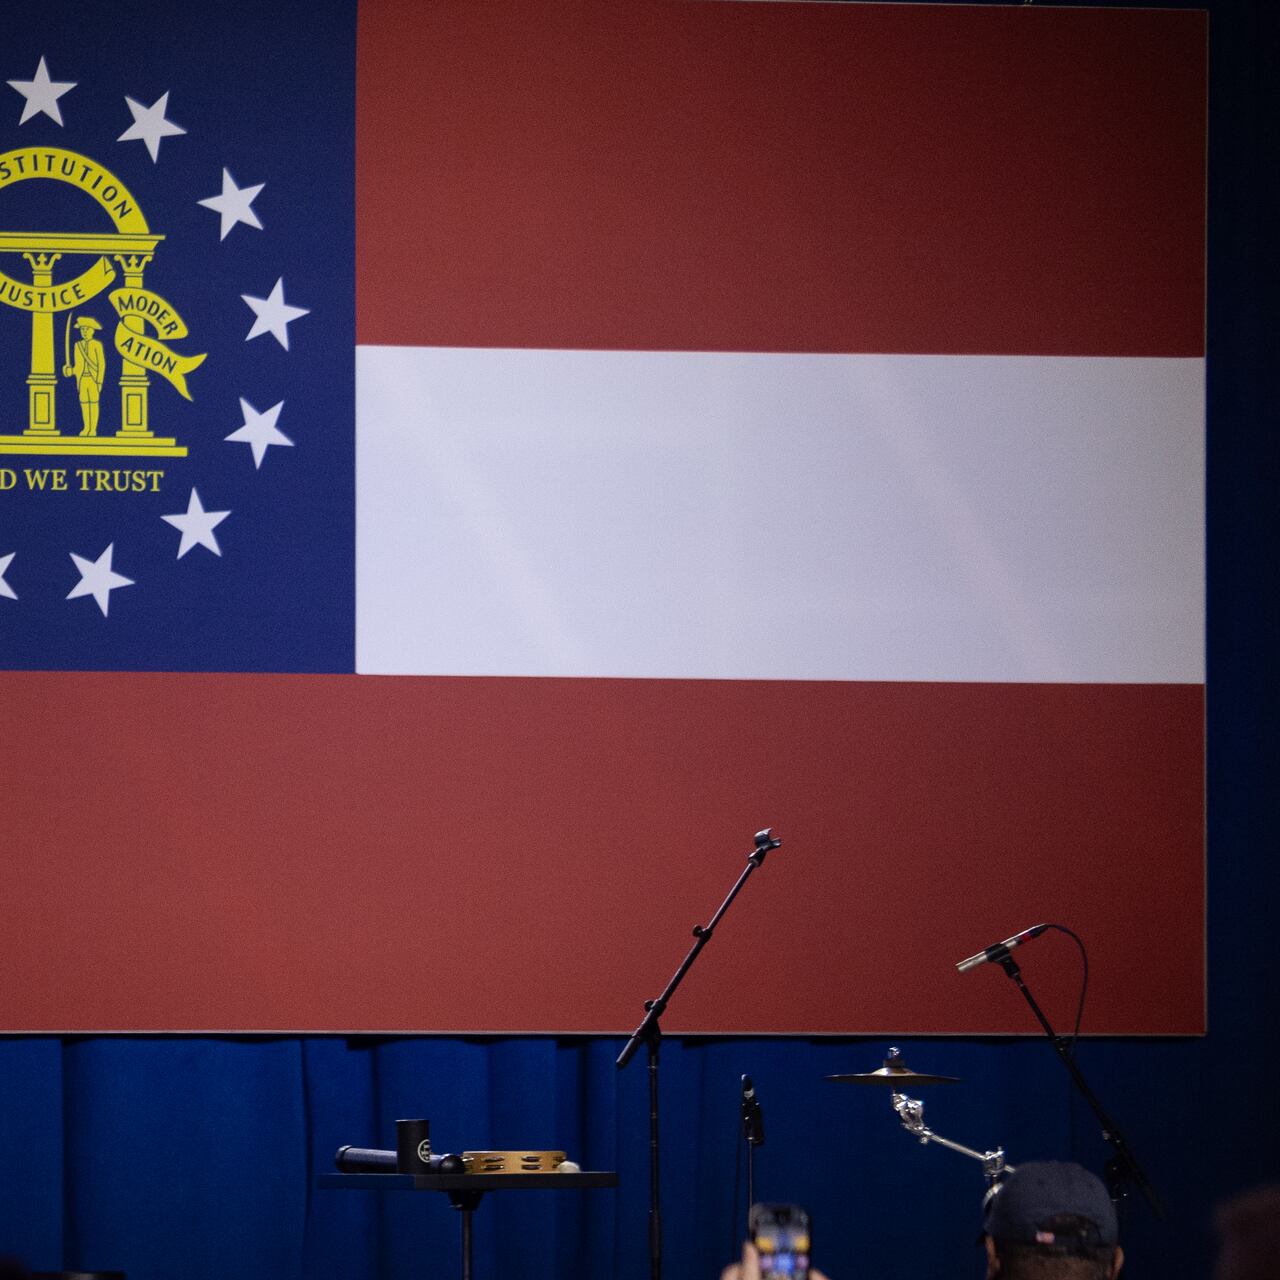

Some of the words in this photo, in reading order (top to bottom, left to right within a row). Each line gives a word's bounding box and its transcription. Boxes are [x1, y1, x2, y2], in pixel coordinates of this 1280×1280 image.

[118, 295, 179, 336] MODER
[120, 337, 178, 373] ATION
[23, 469, 68, 491] WE
[75, 469, 164, 492] TRUST
